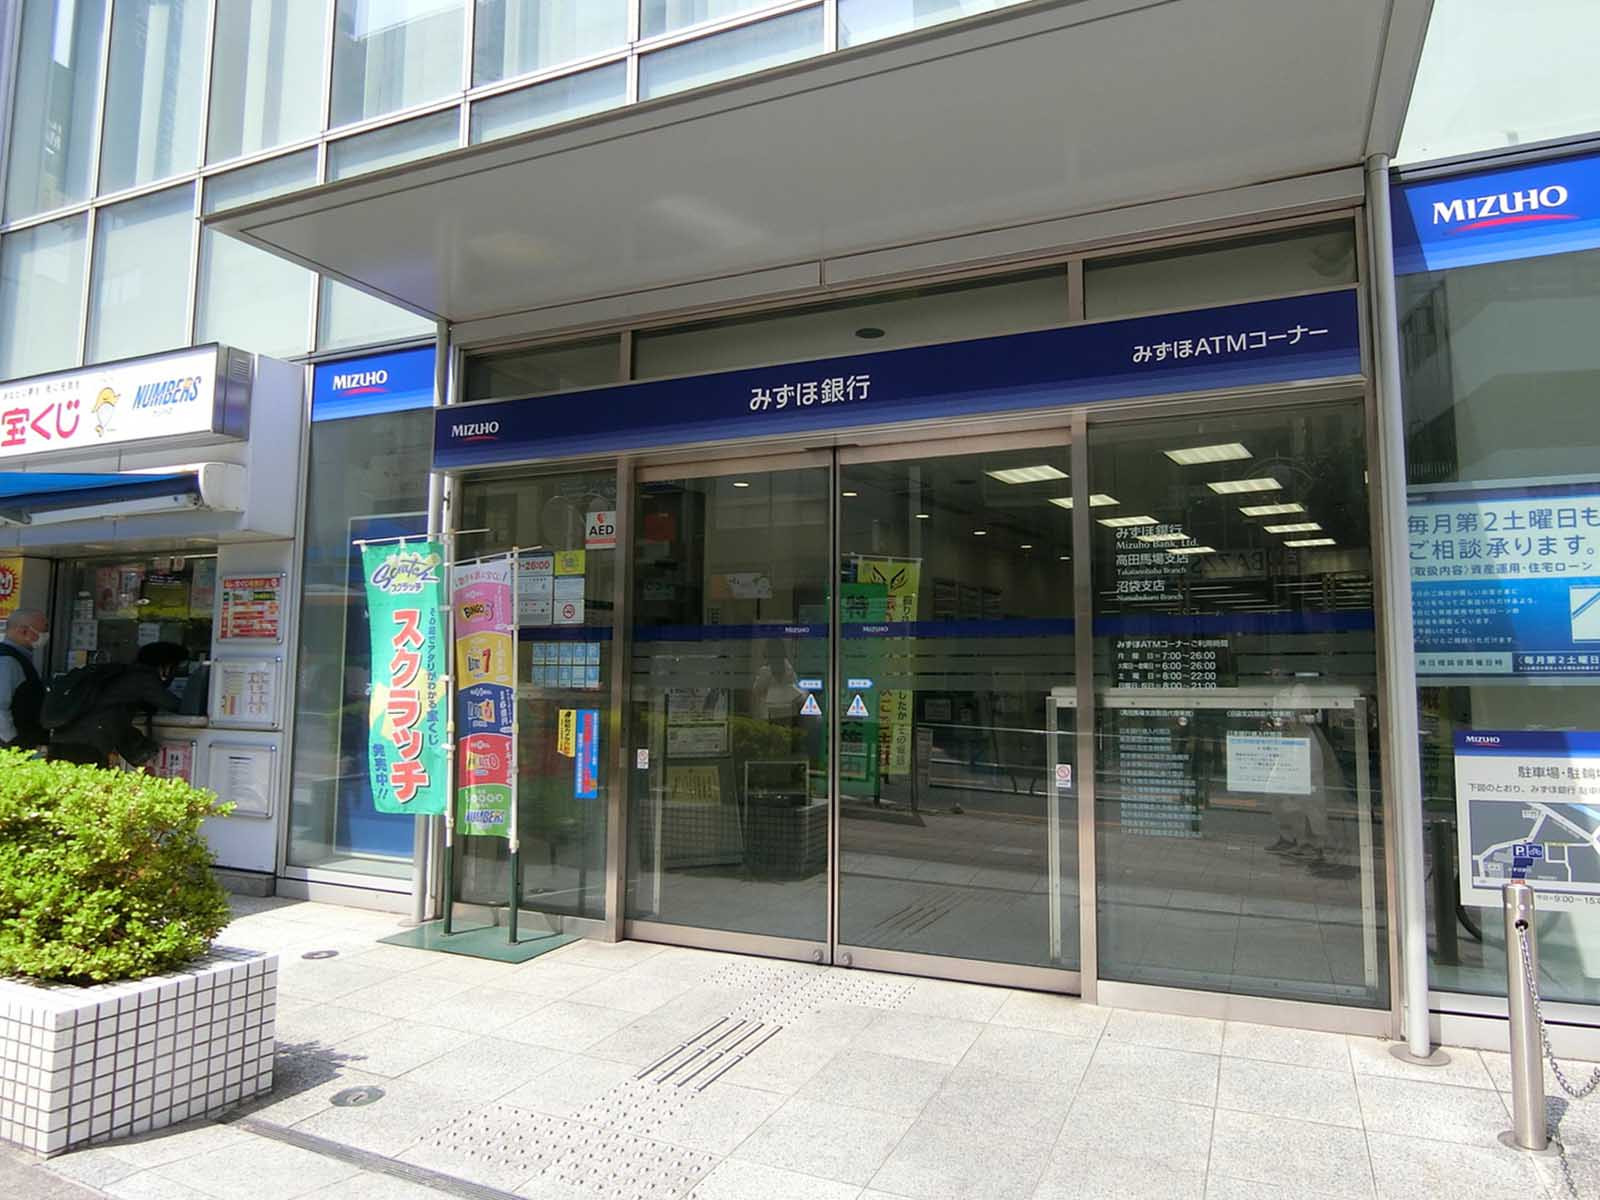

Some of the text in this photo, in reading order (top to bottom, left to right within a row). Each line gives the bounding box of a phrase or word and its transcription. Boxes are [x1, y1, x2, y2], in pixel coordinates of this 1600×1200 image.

[1432, 185, 1569, 225] MIZUHO
[1132, 325, 1329, 363] みずほATMコーナー
[132, 375, 202, 409] NUMBERS
[332, 370, 388, 391] MIZUHO
[749, 375, 871, 411] みずほ銀行
[1, 399, 80, 447] 宝くじ
[451, 421, 500, 438] MIZUHO
[589, 524, 615, 536] AED
[1408, 507, 1600, 535] 毎月第2土曜日も
[1116, 541, 1150, 550] Mizuho
[1408, 535, 1595, 562] ご相談承ります。
[1116, 553, 1189, 567] 高田馬場支店
[1116, 580, 1165, 593] 沼袋支店
[387, 609, 429, 803] スクラッチ
[1465, 735, 1500, 743] MIZUHO
